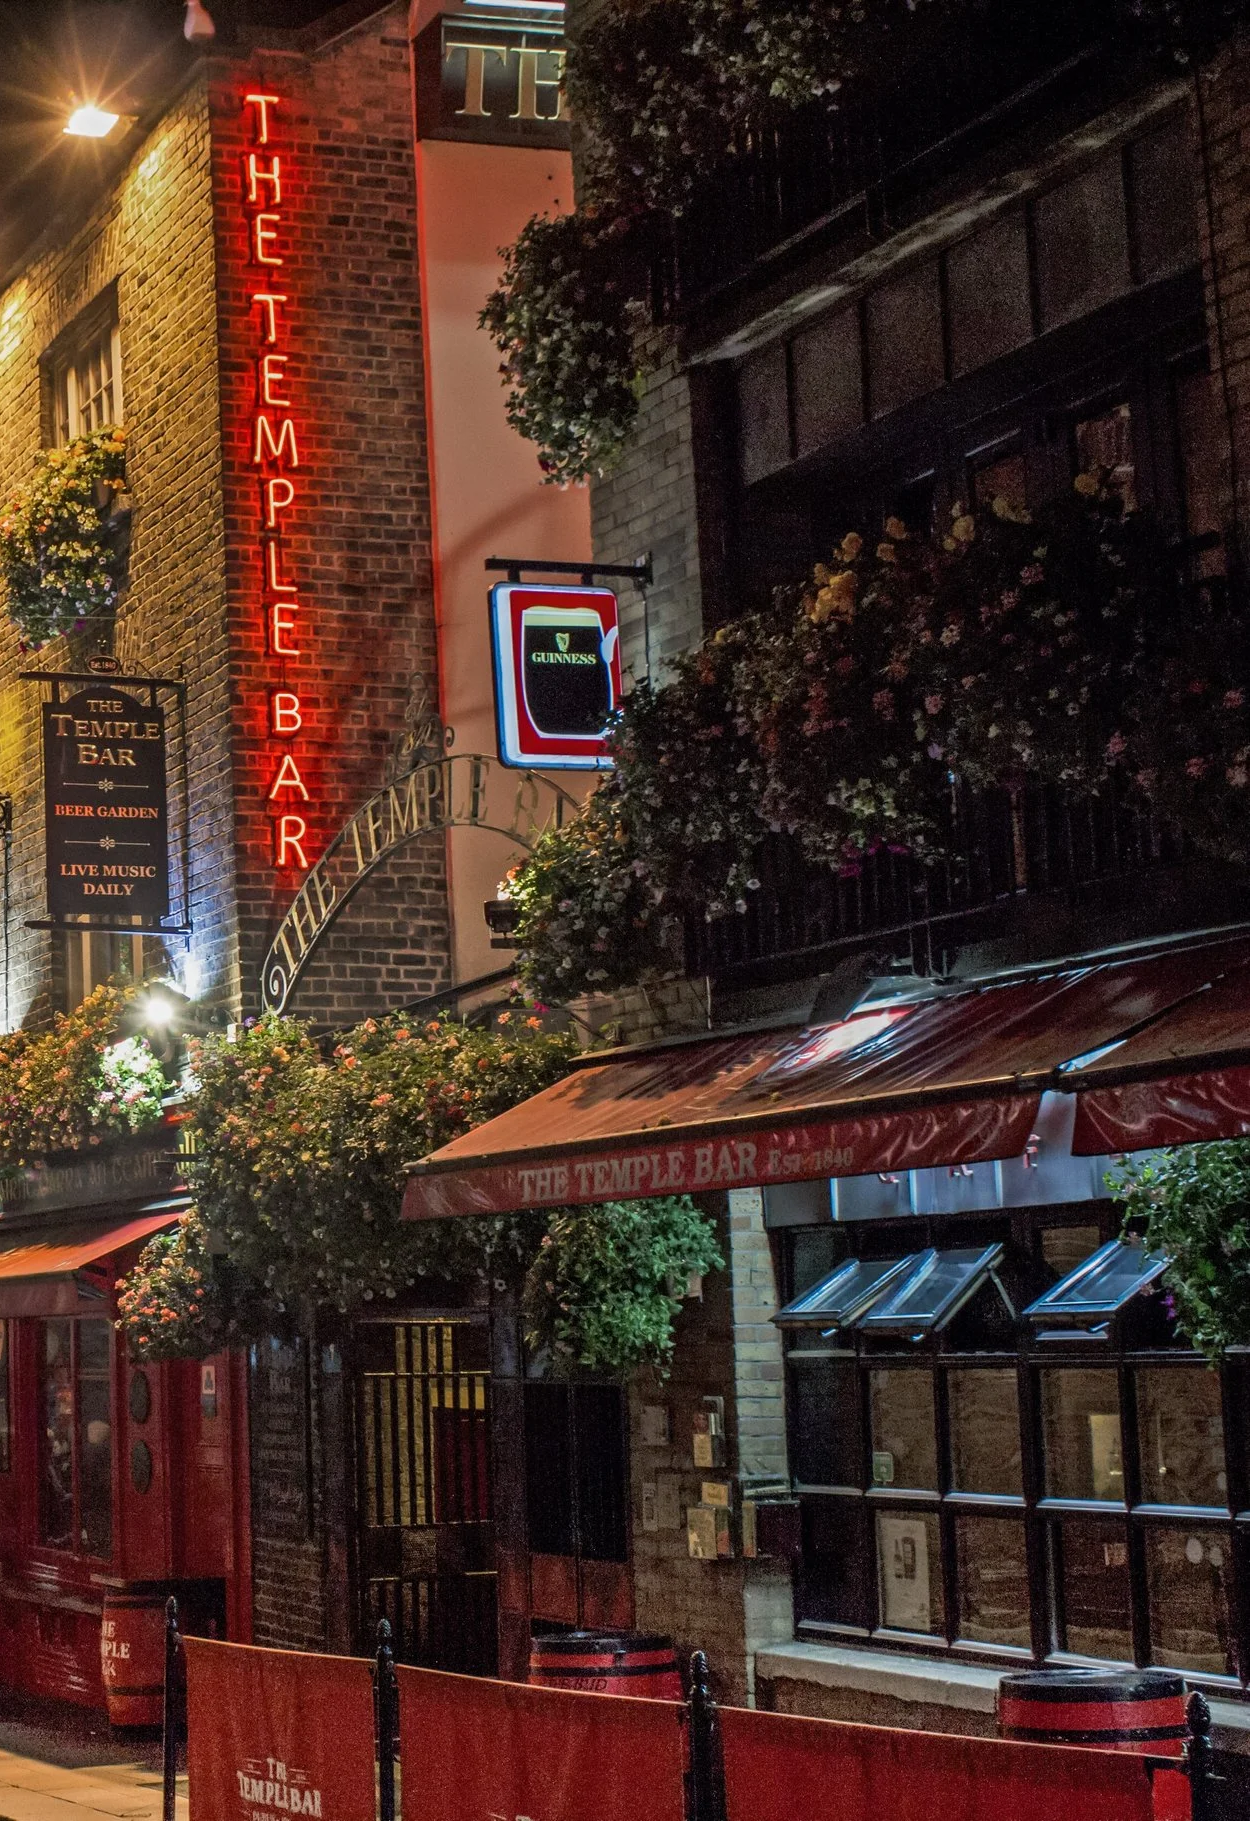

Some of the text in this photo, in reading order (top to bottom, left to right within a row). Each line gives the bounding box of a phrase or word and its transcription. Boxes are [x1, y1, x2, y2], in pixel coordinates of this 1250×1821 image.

[446, 42, 570, 121] TH
[246, 94, 309, 868] THE TEMPLE BAR
[531, 652, 597, 665] GUINNESS
[87, 700, 123, 714] THE
[51, 714, 161, 740] TEMPLE
[77, 743, 136, 767] BAR
[54, 804, 159, 819] BEER GARDEN
[60, 864, 156, 878] LIVE MUSIC
[273, 857, 336, 978] THE
[351, 757, 490, 875] TEMPLE
[83, 883, 134, 896] DAILY
[517, 1166, 568, 1202] THE
[575, 1150, 686, 1197] TEMPLE
[694, 1141, 758, 1185] BAR
[813, 1146, 854, 1171] 1840
